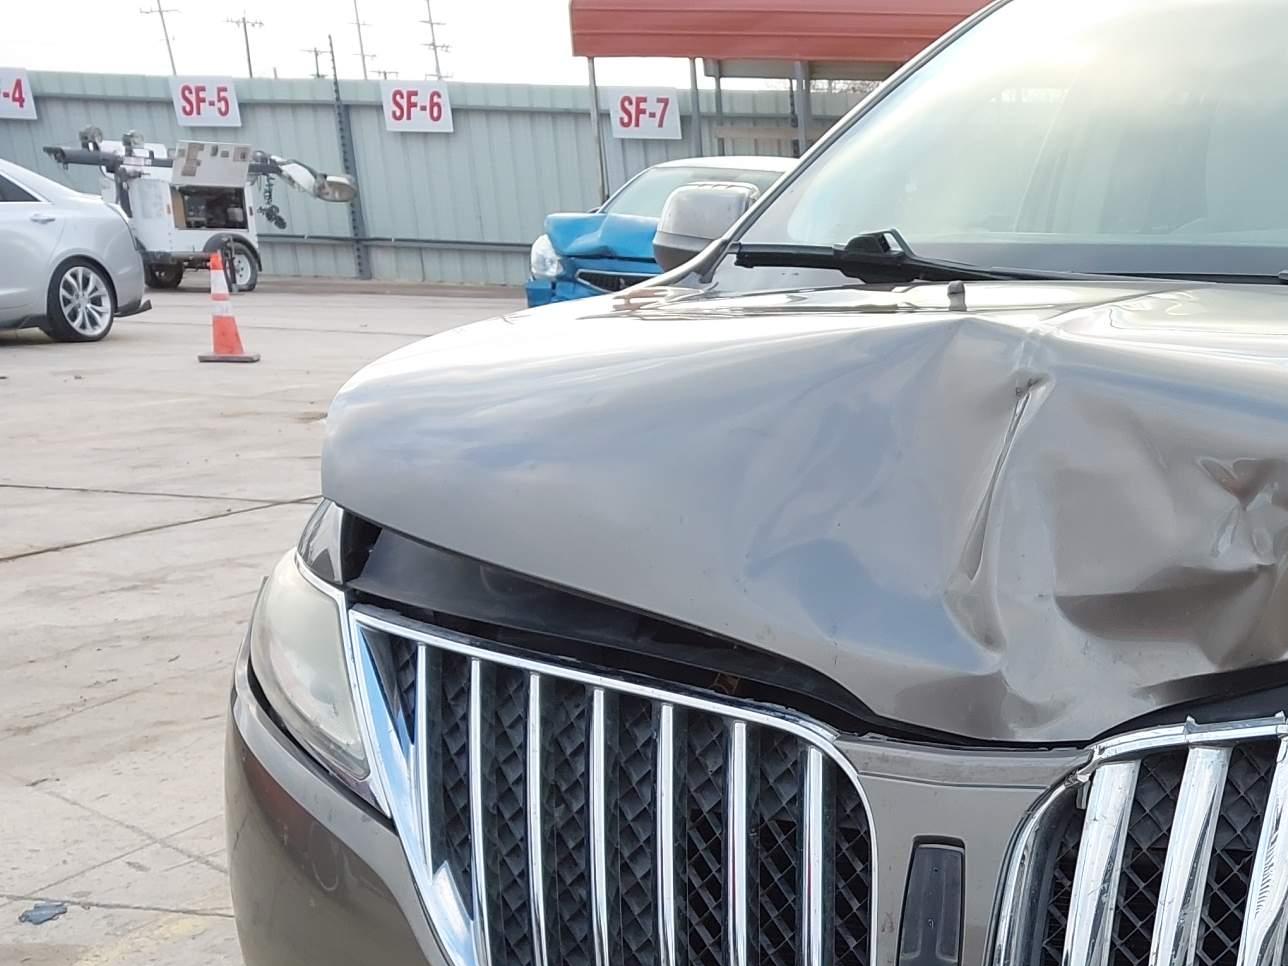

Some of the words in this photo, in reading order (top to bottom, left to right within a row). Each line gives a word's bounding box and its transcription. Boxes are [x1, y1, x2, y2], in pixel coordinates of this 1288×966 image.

[180, 84, 230, 117] SF-5
[391, 89, 442, 122] SF-6
[619, 96, 670, 128] SF-7
